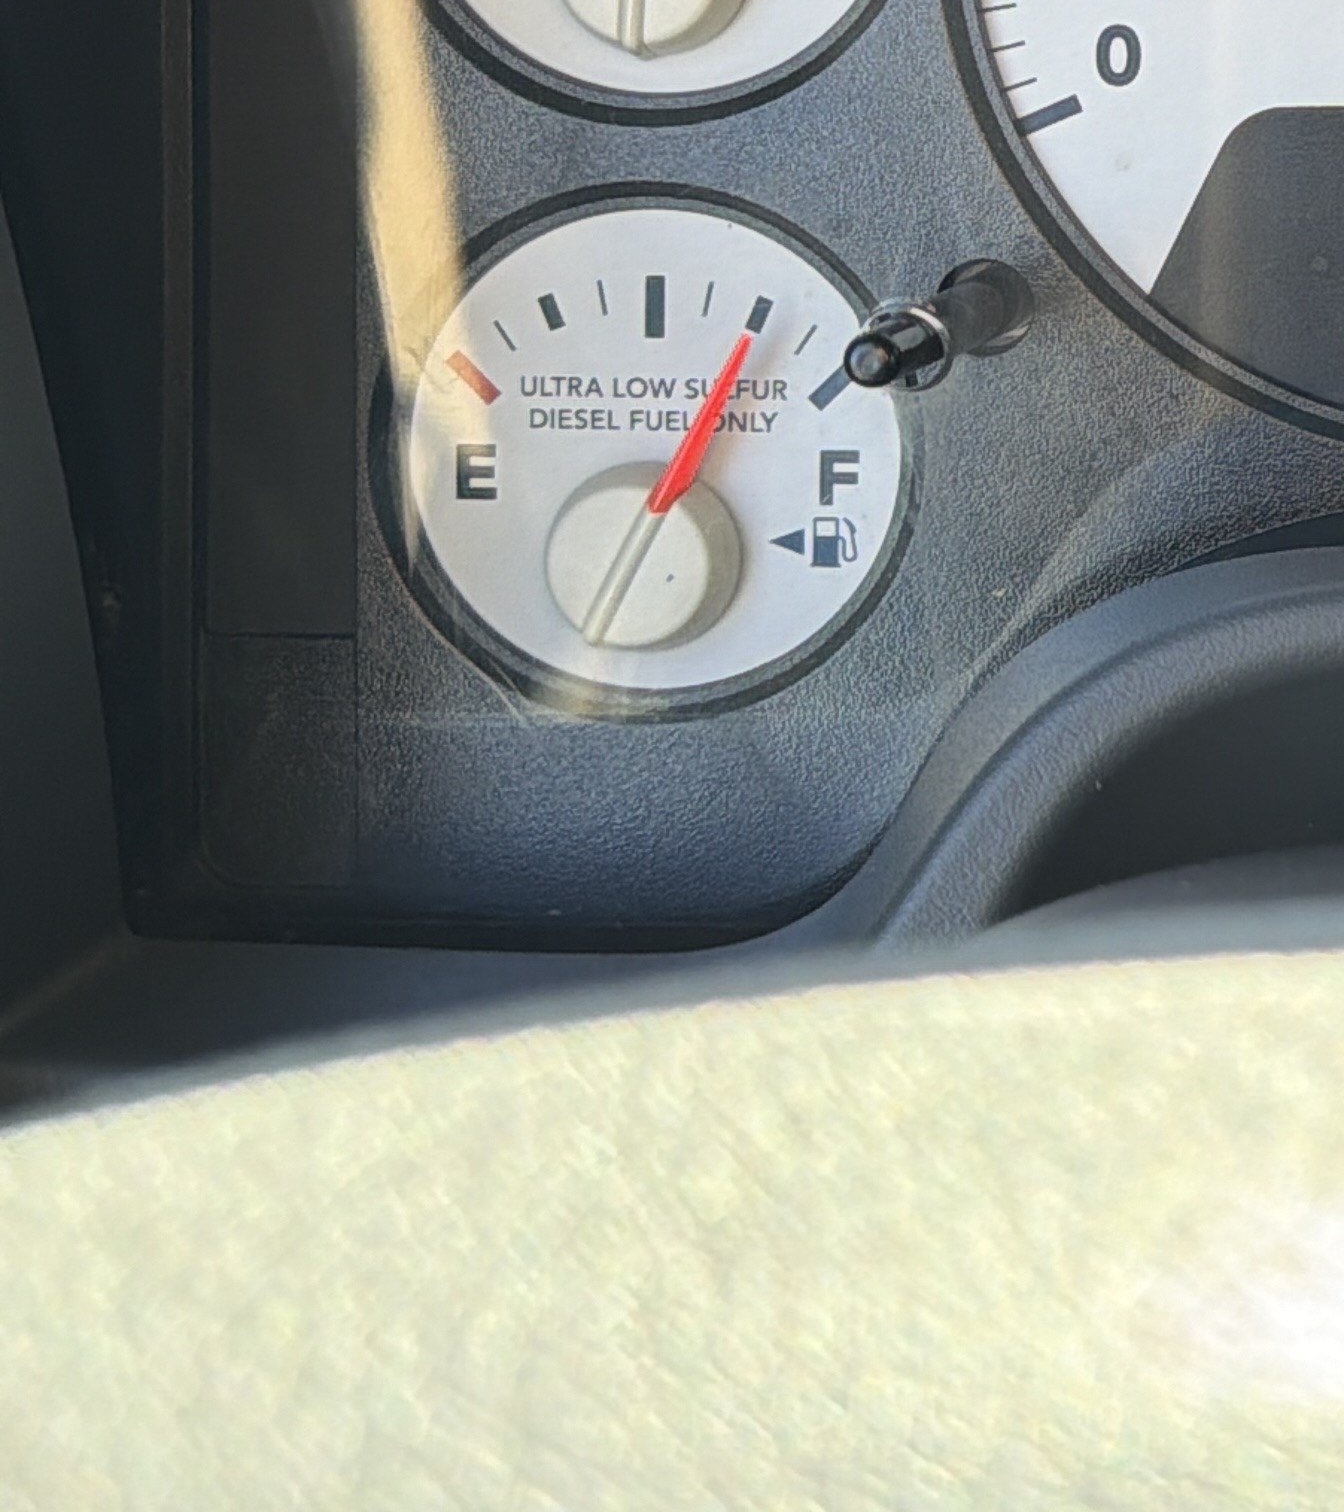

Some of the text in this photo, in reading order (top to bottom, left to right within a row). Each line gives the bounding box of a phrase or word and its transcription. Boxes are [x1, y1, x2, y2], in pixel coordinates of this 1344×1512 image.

[1096, 24, 1141, 87] 0
[520, 376, 788, 401] ULTRA LOW SUFUR
[529, 408, 620, 430] DIESEL
[629, 410, 690, 431] FUEL
[456, 444, 497, 500] E
[820, 450, 860, 505] F
